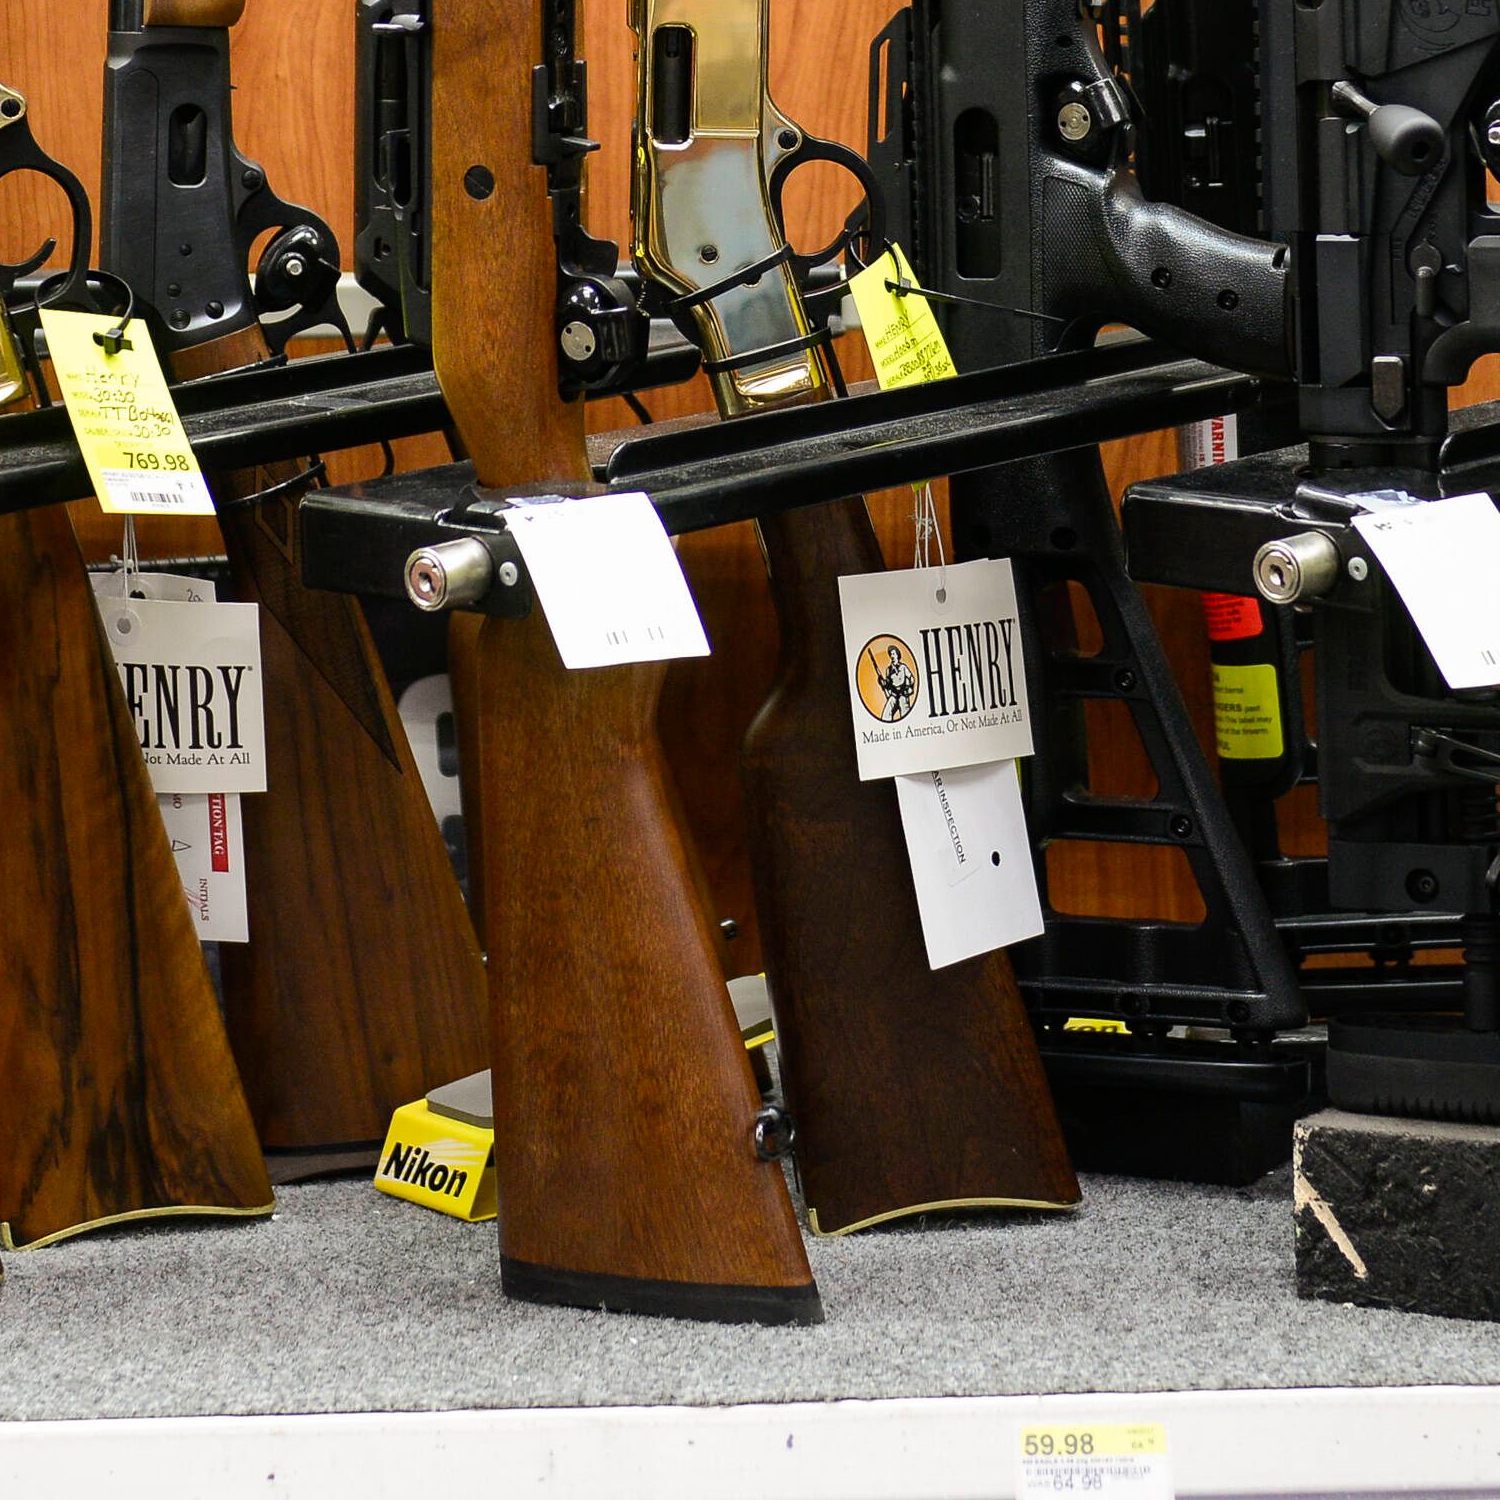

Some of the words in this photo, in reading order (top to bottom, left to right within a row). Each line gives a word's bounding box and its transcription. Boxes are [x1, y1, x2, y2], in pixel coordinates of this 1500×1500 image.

[123, 452, 189, 471] 769.98
[919, 618, 1017, 718] HENRY
[123, 663, 246, 749] ENRY
[862, 731, 890, 744] Made
[892, 728, 902, 741] in
[904, 723, 945, 739] America,
[946, 719, 958, 732] Or
[961, 717, 976, 731] Not
[978, 714, 999, 729] Made
[1000, 712, 1010, 725] At
[1011, 710, 1023, 722] All
[166, 753, 202, 765] Made
[207, 753, 225, 765] At
[229, 752, 250, 764] All
[214, 830, 225, 856] TAG
[939, 788, 967, 864] INSPECTION
[200, 878, 209, 921] INITIALS
[381, 1141, 469, 1198] Nikon
[1024, 1433, 1094, 1456] 59.98
